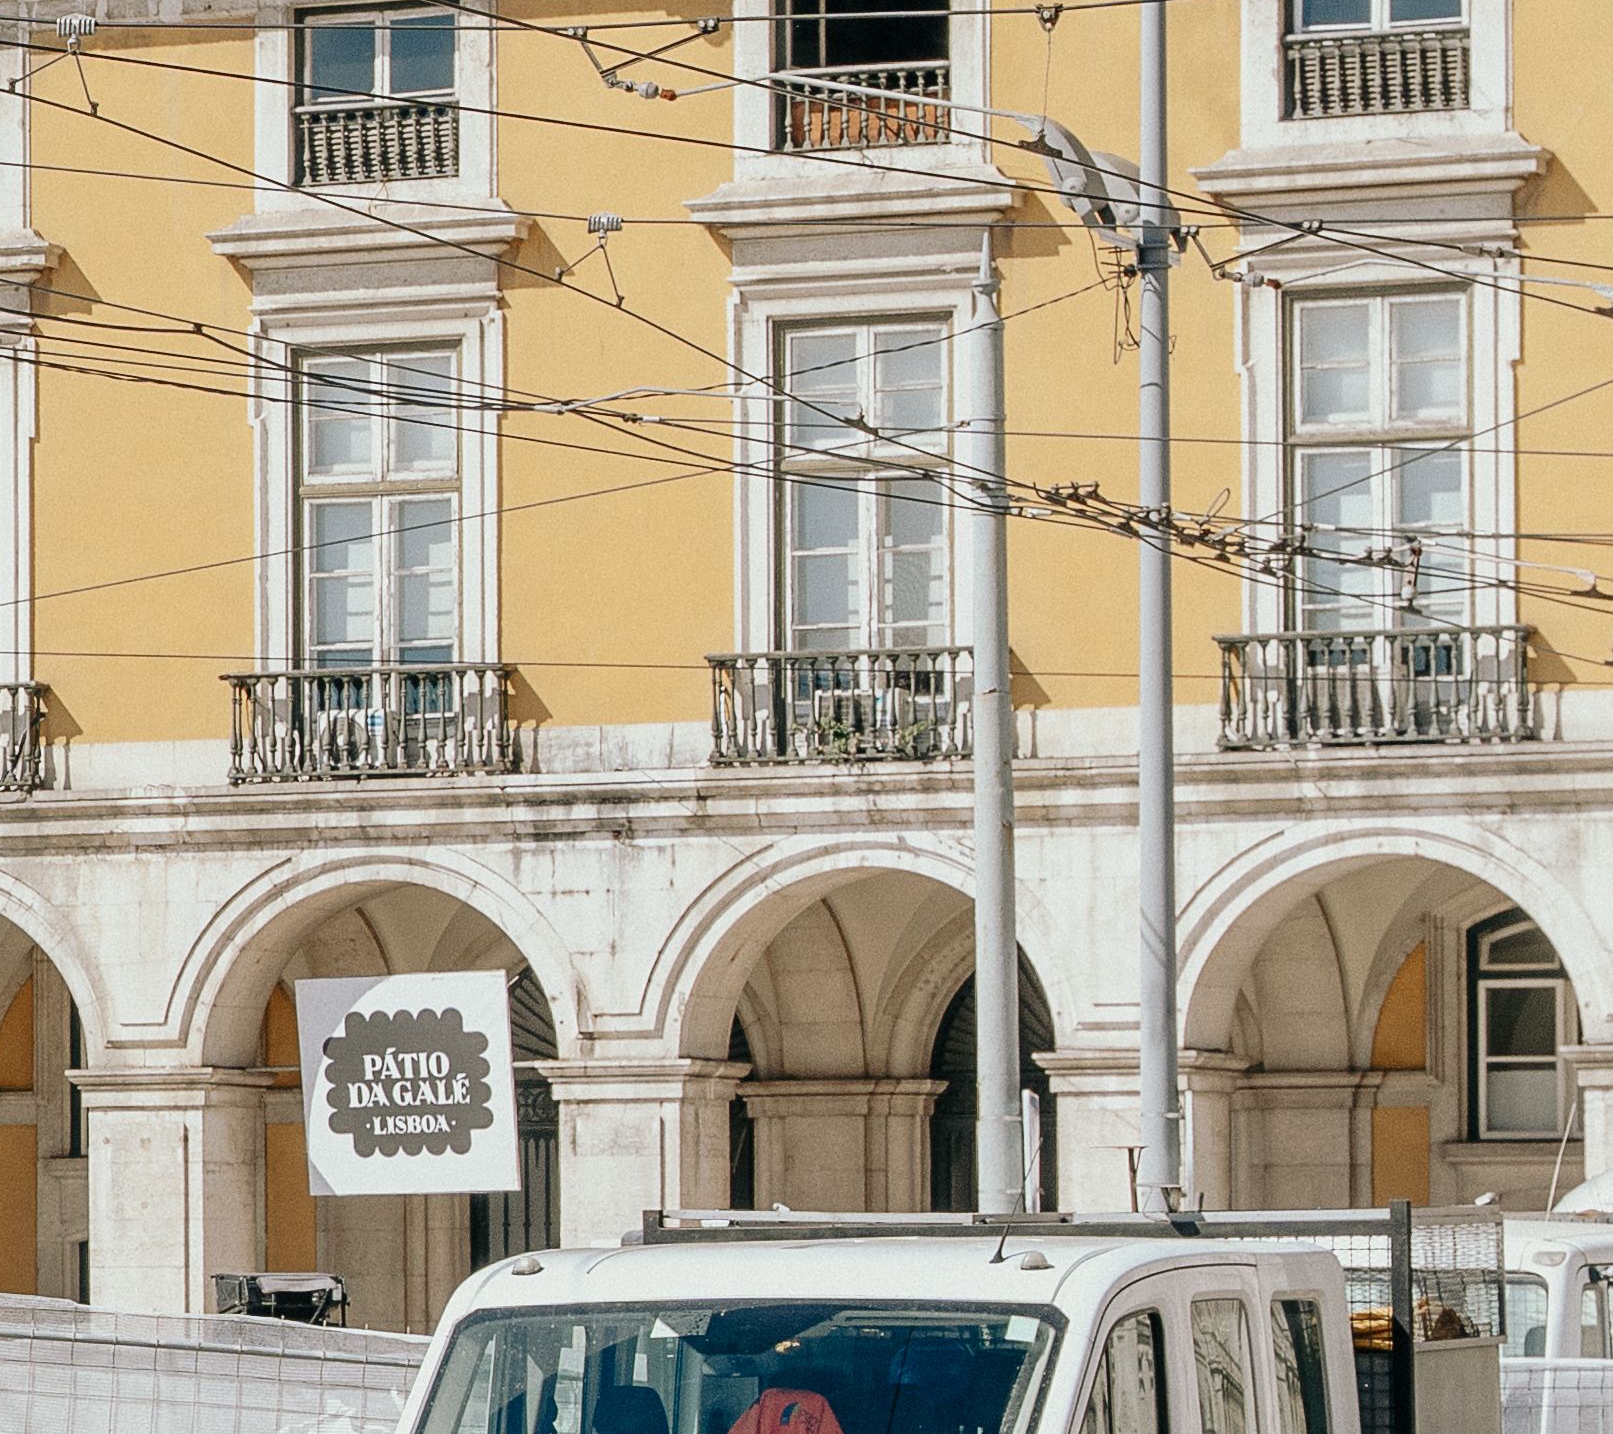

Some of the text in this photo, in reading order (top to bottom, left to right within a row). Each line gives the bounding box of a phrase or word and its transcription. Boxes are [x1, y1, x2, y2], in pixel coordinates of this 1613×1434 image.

[362, 1047, 450, 1080] PÁTIO
[347, 1072, 471, 1108] DA GALÉ
